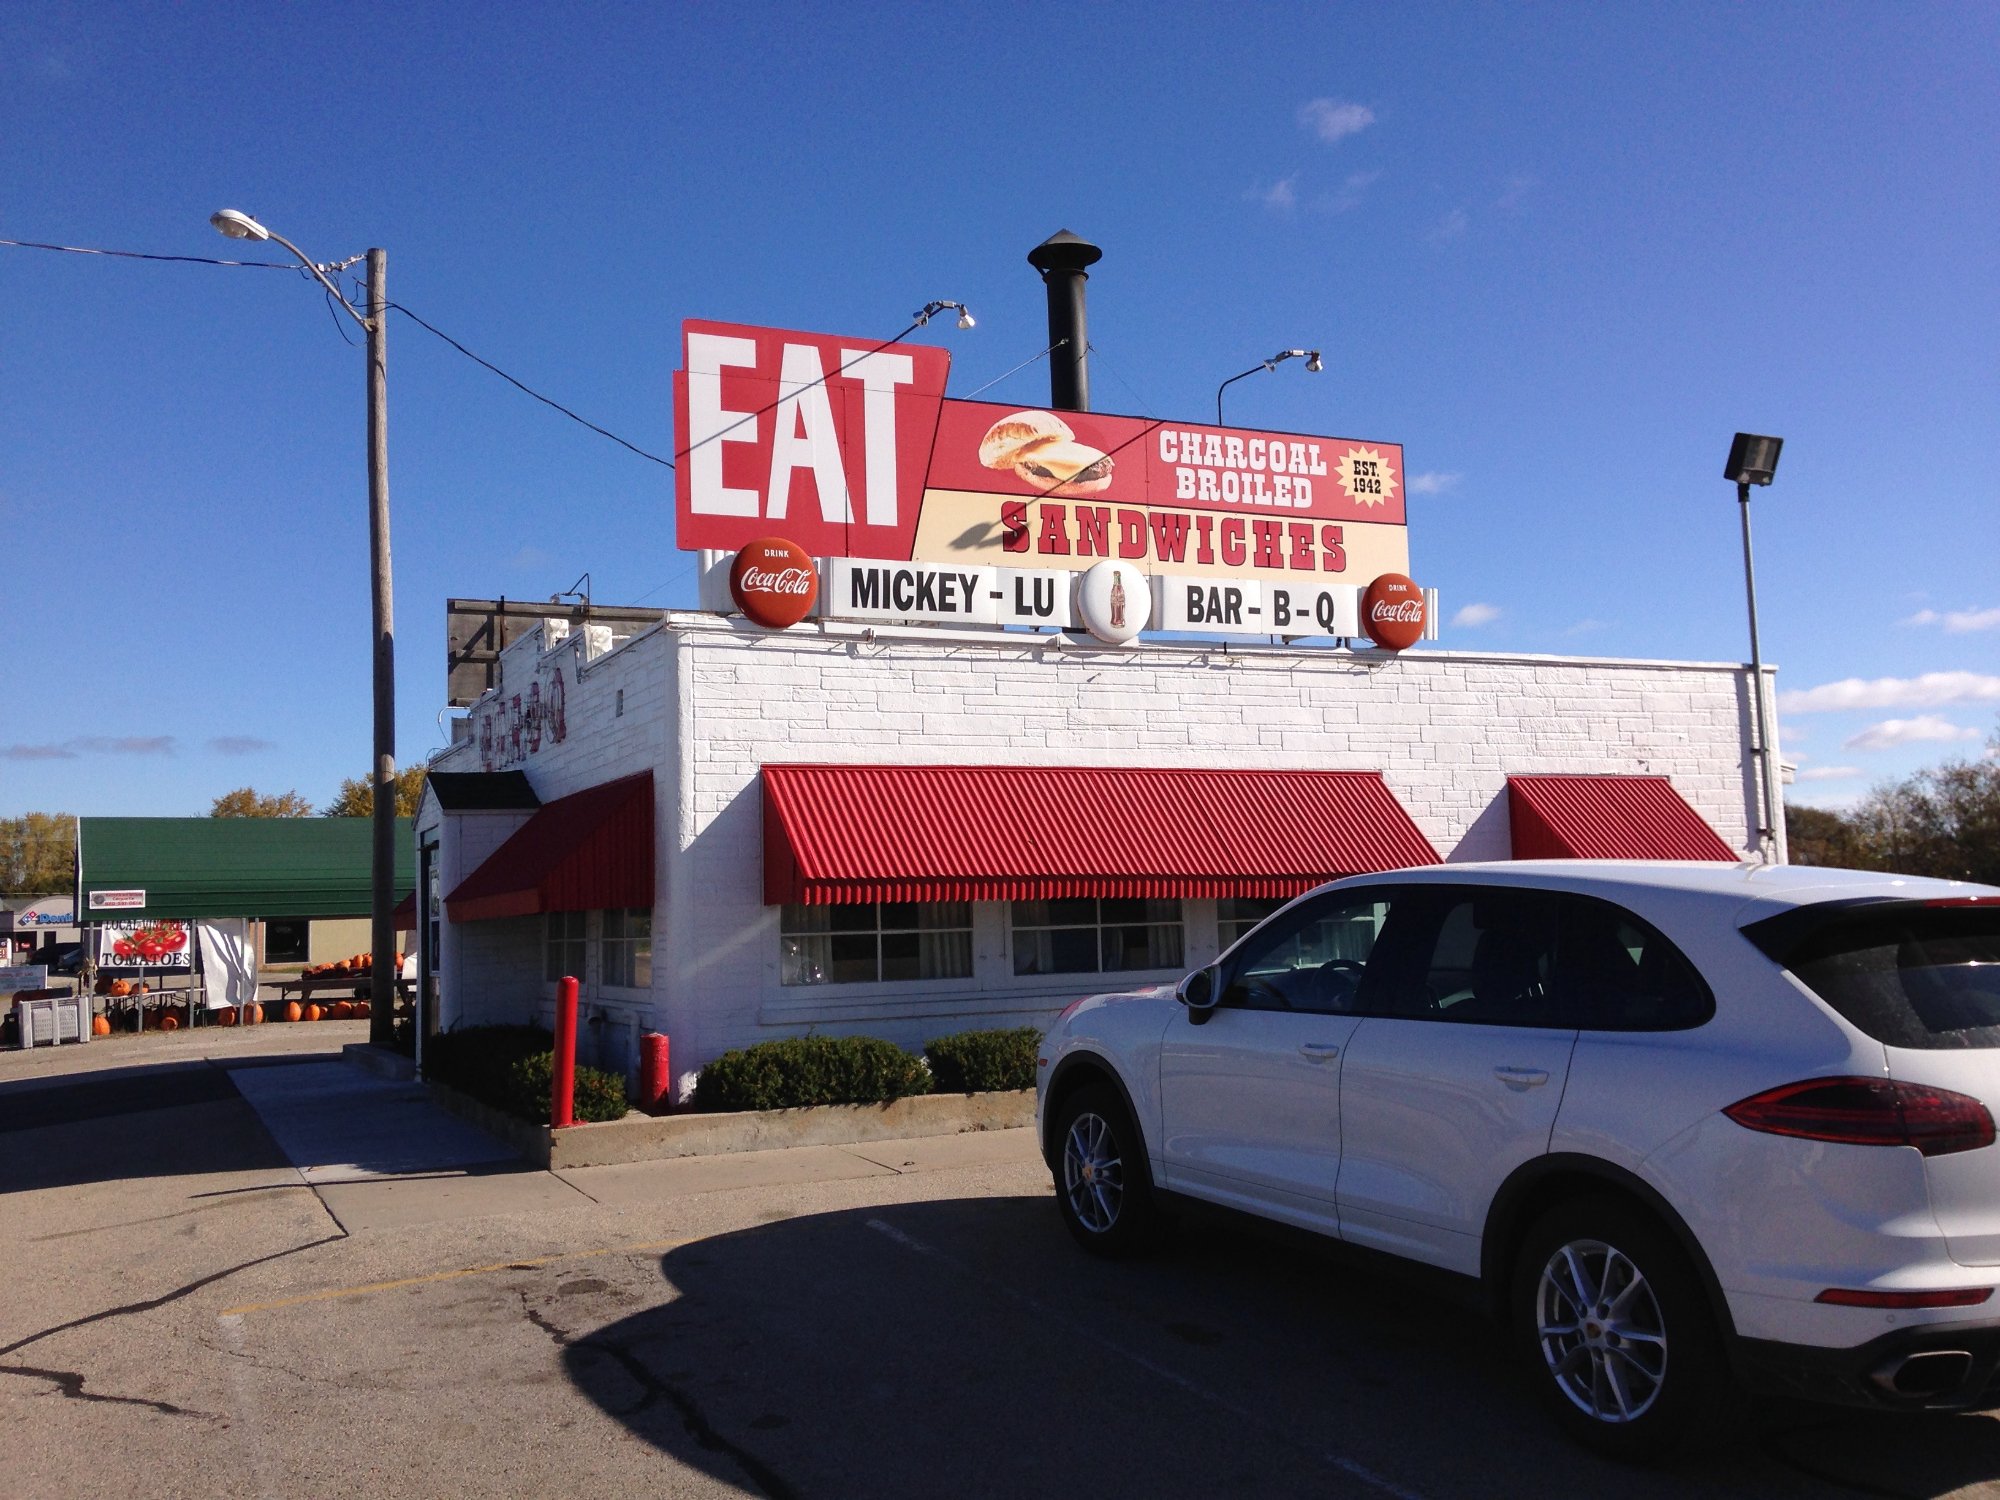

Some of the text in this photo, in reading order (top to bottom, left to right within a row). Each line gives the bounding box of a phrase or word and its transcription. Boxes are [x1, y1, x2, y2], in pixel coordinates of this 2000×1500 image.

[688, 332, 913, 527] EAT
[1159, 430, 1327, 476] CHARCOAL
[1353, 460, 1380, 477] EST.
[1175, 467, 1313, 508] BROILED
[1353, 478, 1382, 495] 1942
[1000, 500, 1346, 573] SANDWICHES
[764, 549, 789, 558] DRINK
[741, 566, 812, 594] Coca-Cola
[1388, 584, 1408, 592] DRINK
[1371, 599, 1424, 622] Coca-Cola
[101, 952, 191, 966] TOMATOES
